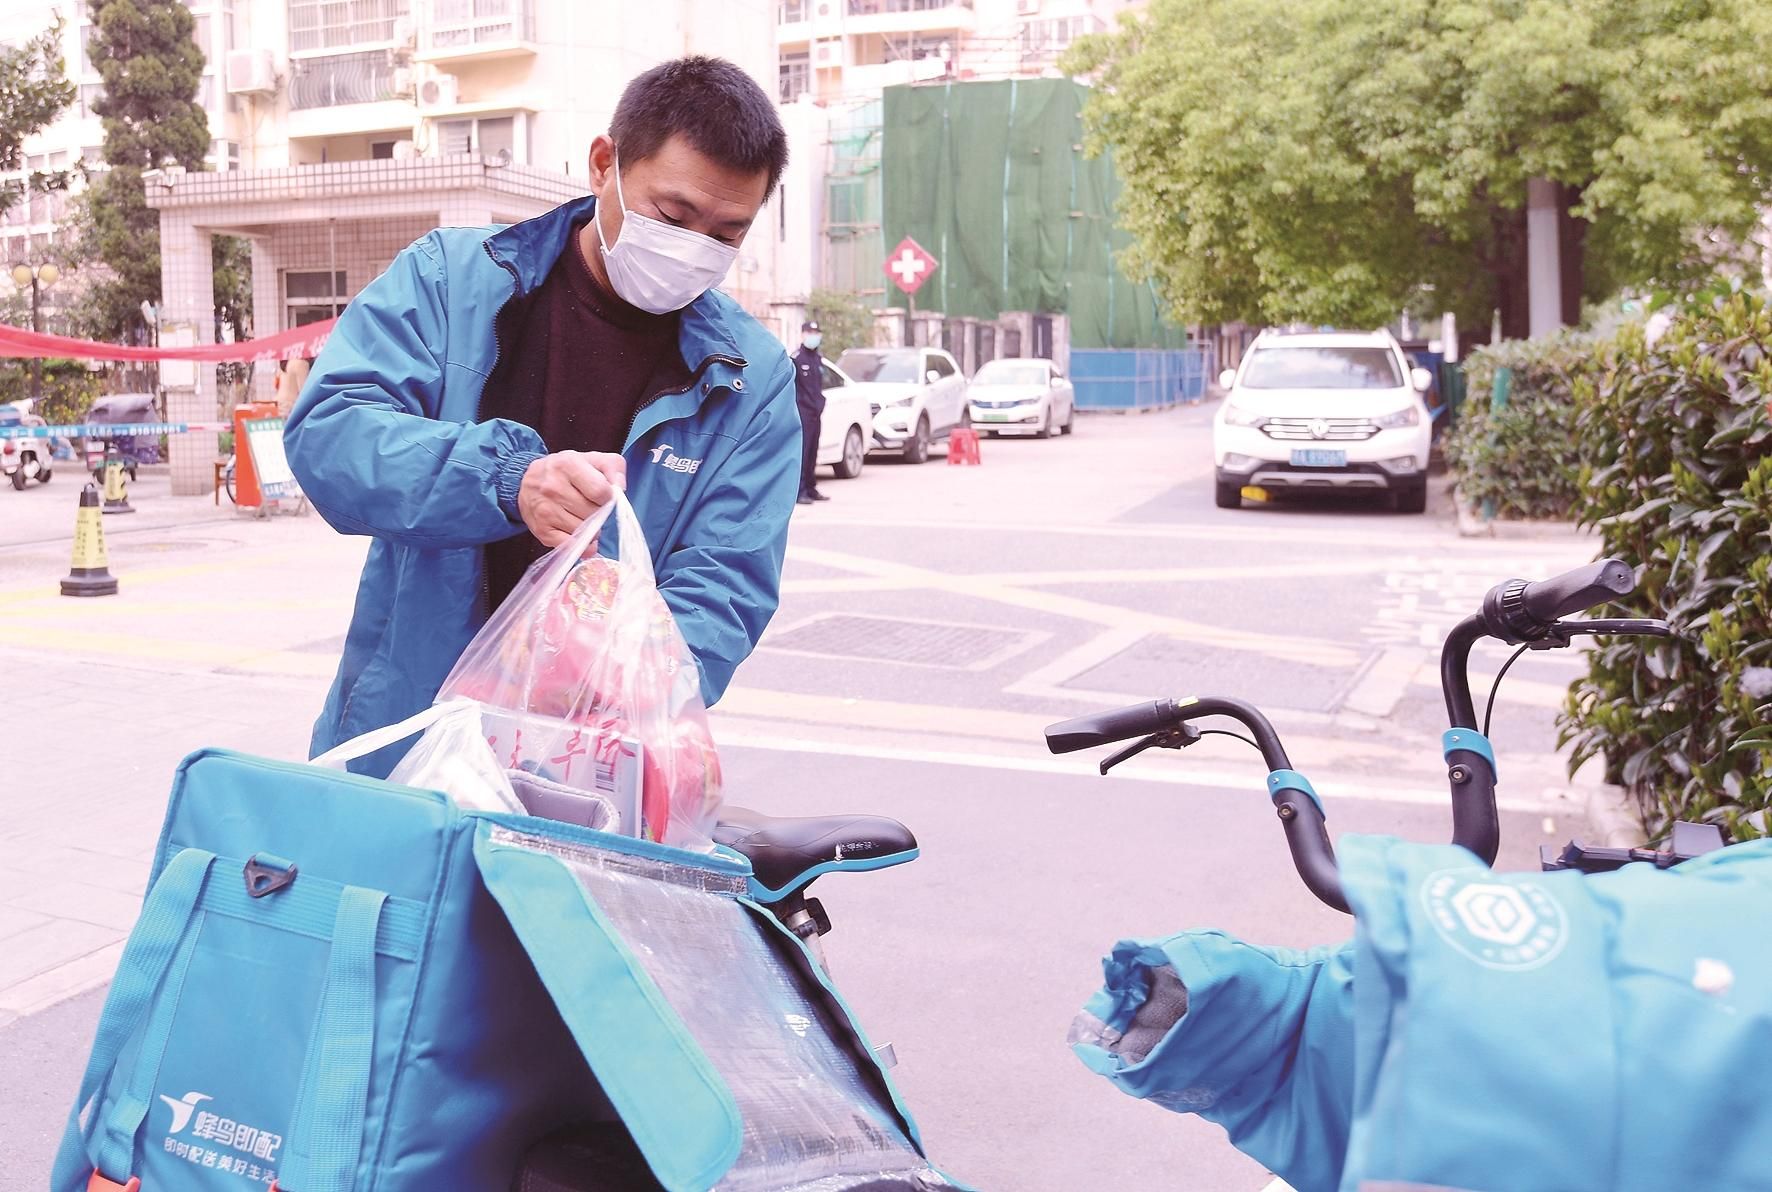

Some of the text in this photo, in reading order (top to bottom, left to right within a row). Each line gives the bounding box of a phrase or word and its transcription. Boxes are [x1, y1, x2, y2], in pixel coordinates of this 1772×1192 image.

[164, 1137, 277, 1185] 即时配送美好生活
[192, 1111, 282, 1162] 蜂鸟即配
